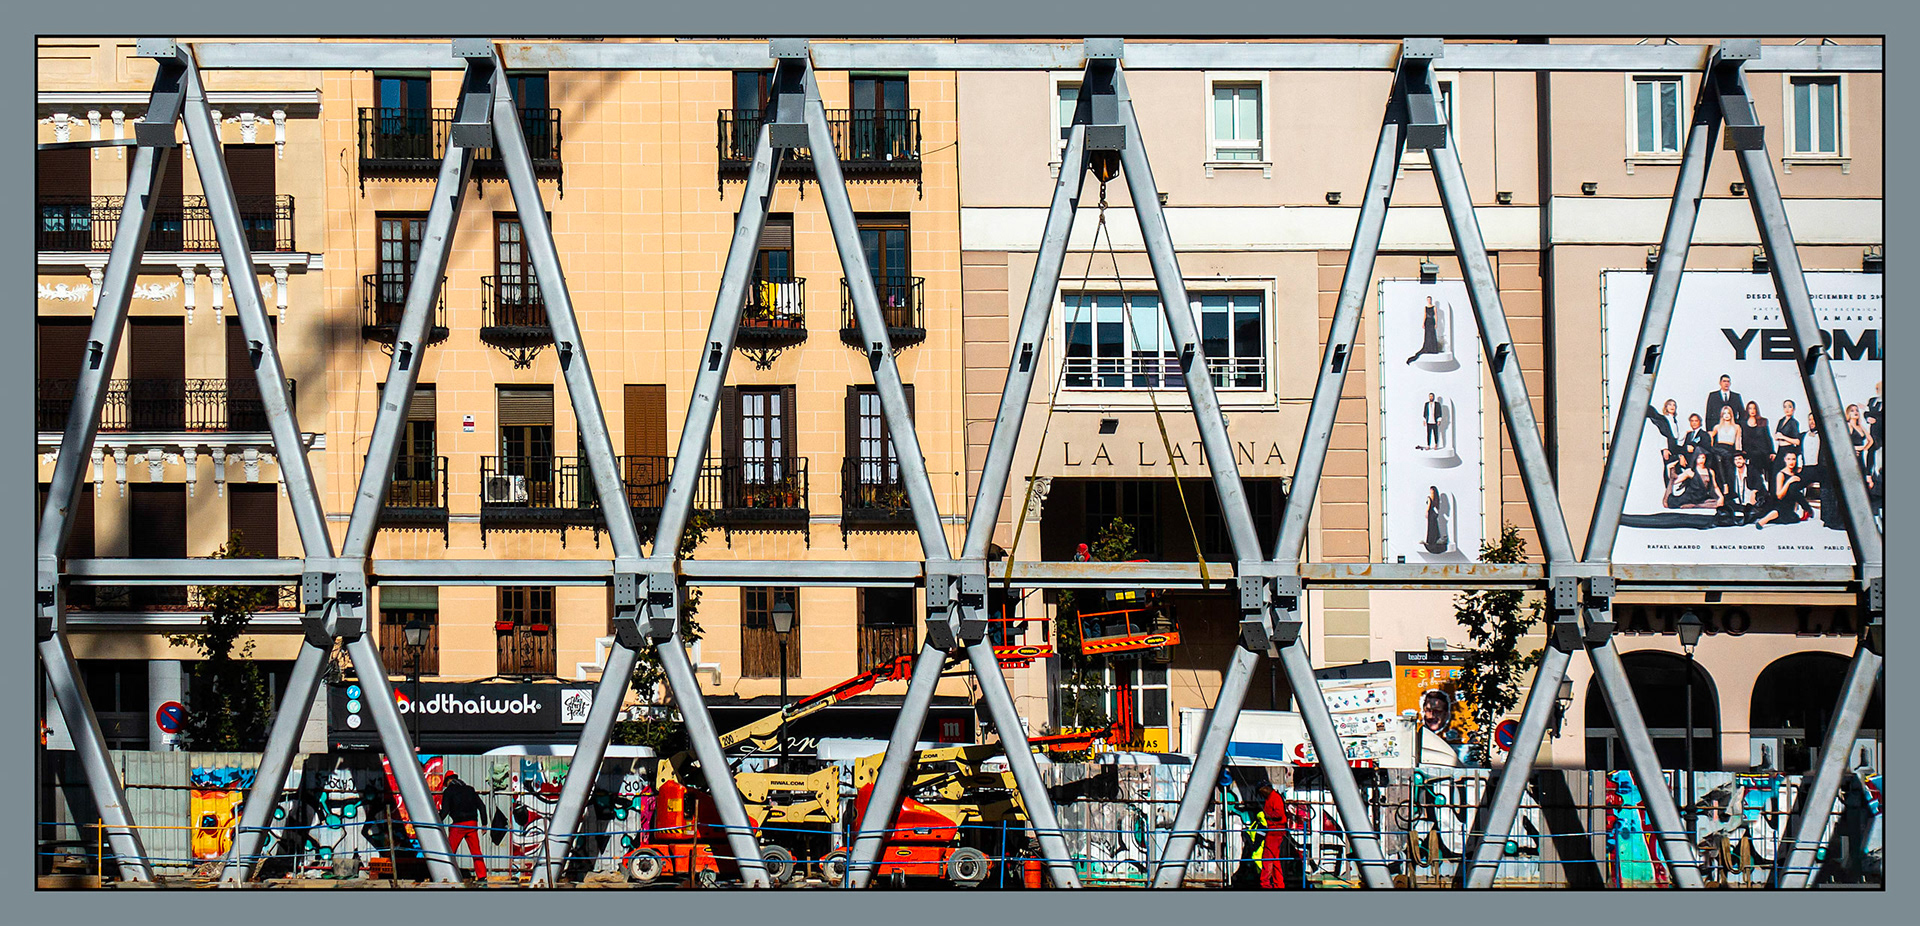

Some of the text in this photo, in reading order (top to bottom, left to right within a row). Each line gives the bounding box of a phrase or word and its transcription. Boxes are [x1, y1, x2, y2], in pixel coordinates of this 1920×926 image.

[1063, 440, 1286, 467] LA LATNA
[721, 734, 735, 746] 200
